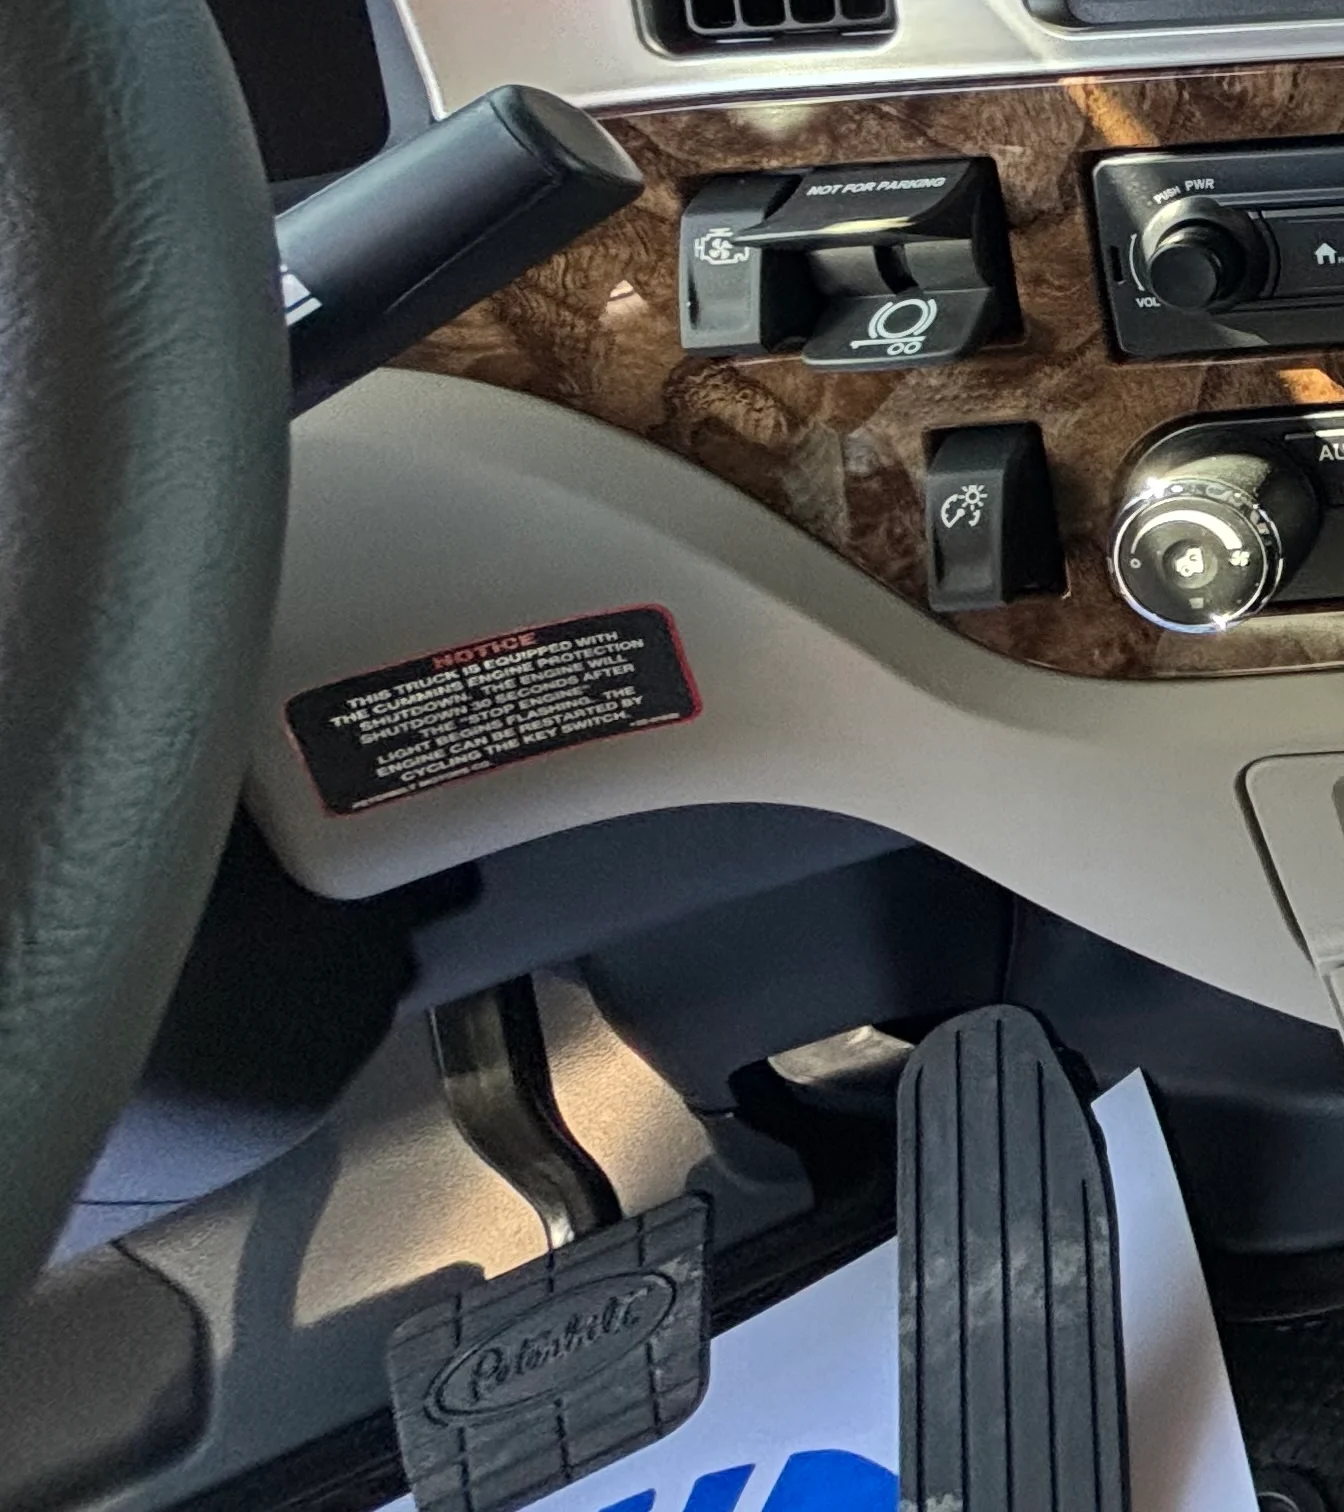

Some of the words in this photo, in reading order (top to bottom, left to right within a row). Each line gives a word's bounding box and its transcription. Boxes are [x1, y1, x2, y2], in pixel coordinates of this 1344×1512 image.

[806, 184, 843, 196] NOT
[841, 181, 876, 194] FOR
[876, 177, 946, 192] PARKING
[1153, 185, 1181, 204] PUSH
[1184, 178, 1215, 191] PWR
[1135, 297, 1161, 308] VOL
[347, 689, 393, 709] THIS
[393, 670, 461, 696] TRUCK
[461, 663, 481, 676] IS
[483, 641, 573, 671] EQUIPPED
[574, 631, 619, 647] WITH
[432, 631, 537, 670] NOTICE
[329, 708, 370, 728] THE
[371, 681, 464, 714] CUMMINS
[466, 661, 535, 688] ENGINE
[536, 639, 645, 669] PROTECTION
[479, 678, 517, 696] THE
[519, 662, 585, 685] ENGINE
[586, 654, 628, 669] WILL
[359, 705, 468, 745] SHUTDOWN
[469, 698, 492, 712] 30
[495, 675, 580, 705] SECONDS
[582, 663, 636, 682] AFTER
[376, 740, 432, 765] LIGHT
[435, 719, 504, 746] BEGINS
[602, 686, 636, 701] THE
[375, 748, 447, 779] ENGINE
[449, 736, 488, 754] CAN
[491, 727, 516, 742] BE
[518, 701, 619, 734] RESTARTED
[621, 695, 643, 709] BY
[417, 720, 457, 738] THE
[400, 750, 482, 782] CYCLING
[483, 738, 520, 756] THE
[522, 727, 559, 745] KEY
